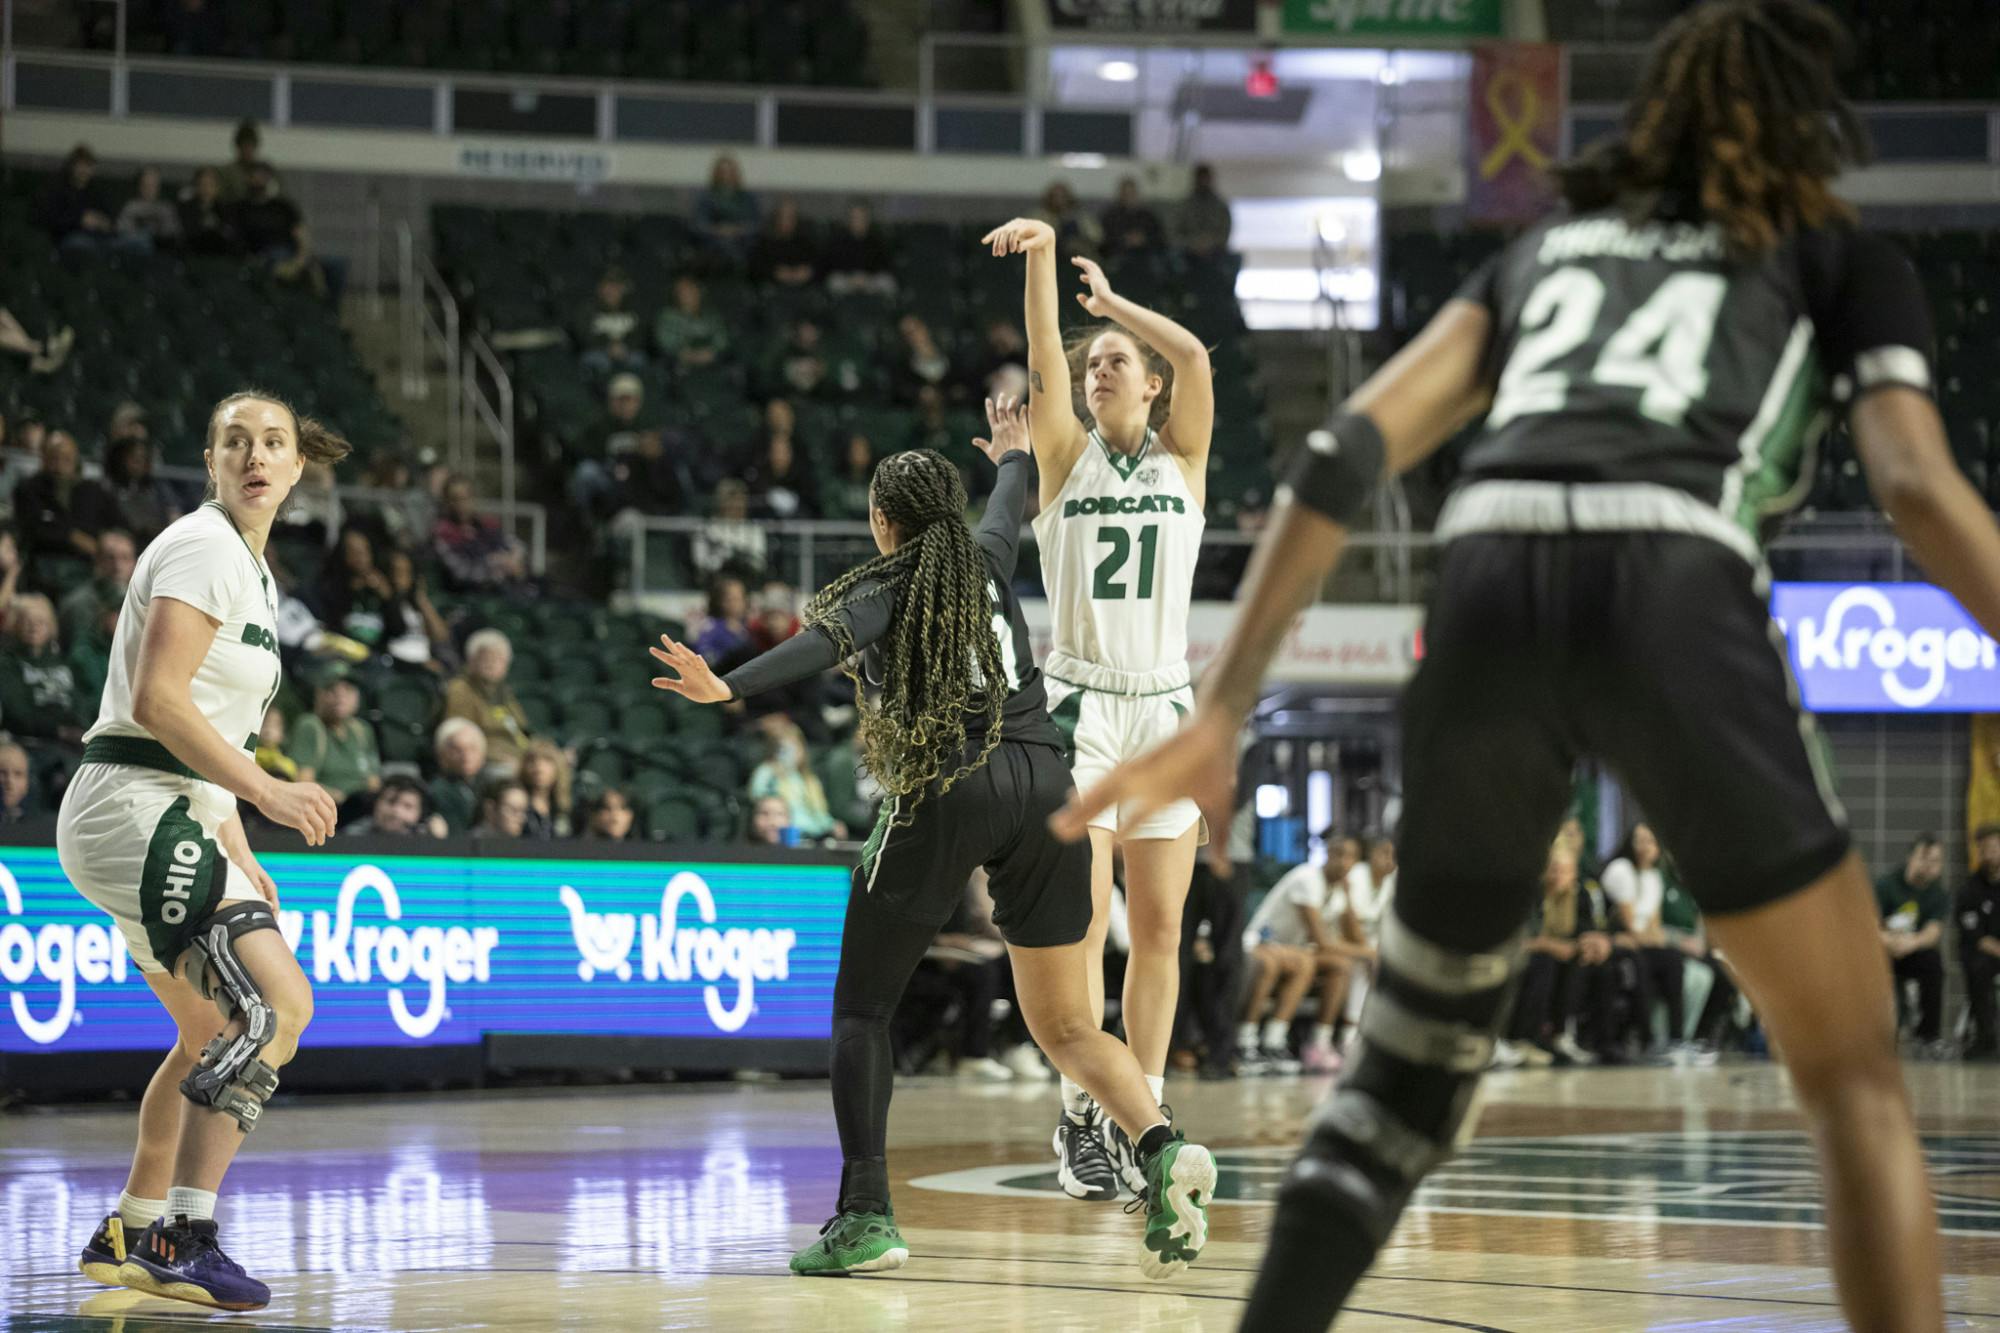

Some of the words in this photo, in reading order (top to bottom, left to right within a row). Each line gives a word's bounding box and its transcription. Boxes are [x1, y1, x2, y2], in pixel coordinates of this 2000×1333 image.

[1485, 265, 1728, 429] 24
[1063, 494, 1186, 519] BOBCATS
[1092, 524, 1158, 600] 21
[161, 840, 202, 925] OHIO
[312, 864, 499, 1038] Kroger
[640, 871, 797, 1032] Kroger
